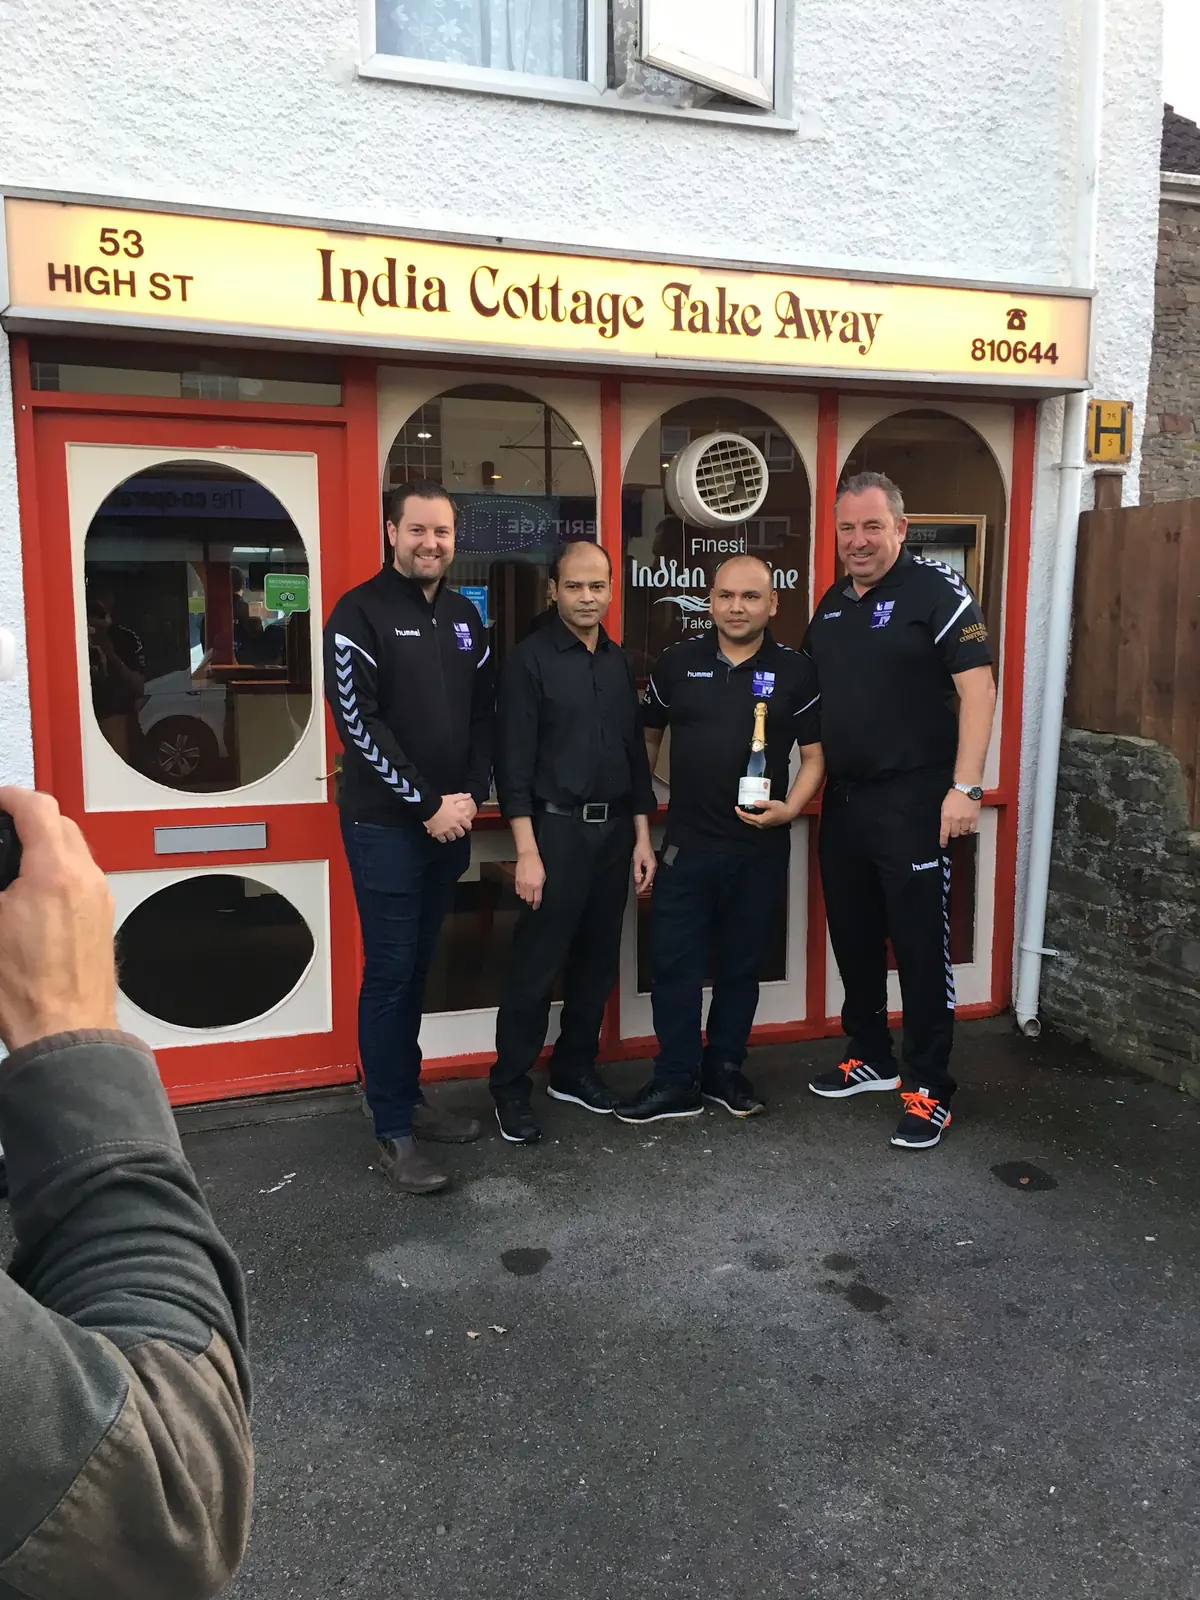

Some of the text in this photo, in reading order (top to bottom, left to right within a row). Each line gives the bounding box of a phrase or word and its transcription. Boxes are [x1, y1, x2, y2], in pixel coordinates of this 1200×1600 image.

[98, 227, 145, 259] 53
[47, 262, 194, 302] HIGH ST
[317, 248, 884, 355] India Cottage Take Away
[970, 338, 1060, 365] 810644
[1094, 404, 1127, 455] H
[1106, 412, 1117, 421] 75
[691, 537, 745, 556] Finest
[632, 555, 706, 588] Indian
[394, 627, 421, 637] hummel
[682, 616, 713, 629] Take
[687, 670, 714, 678] hummel
